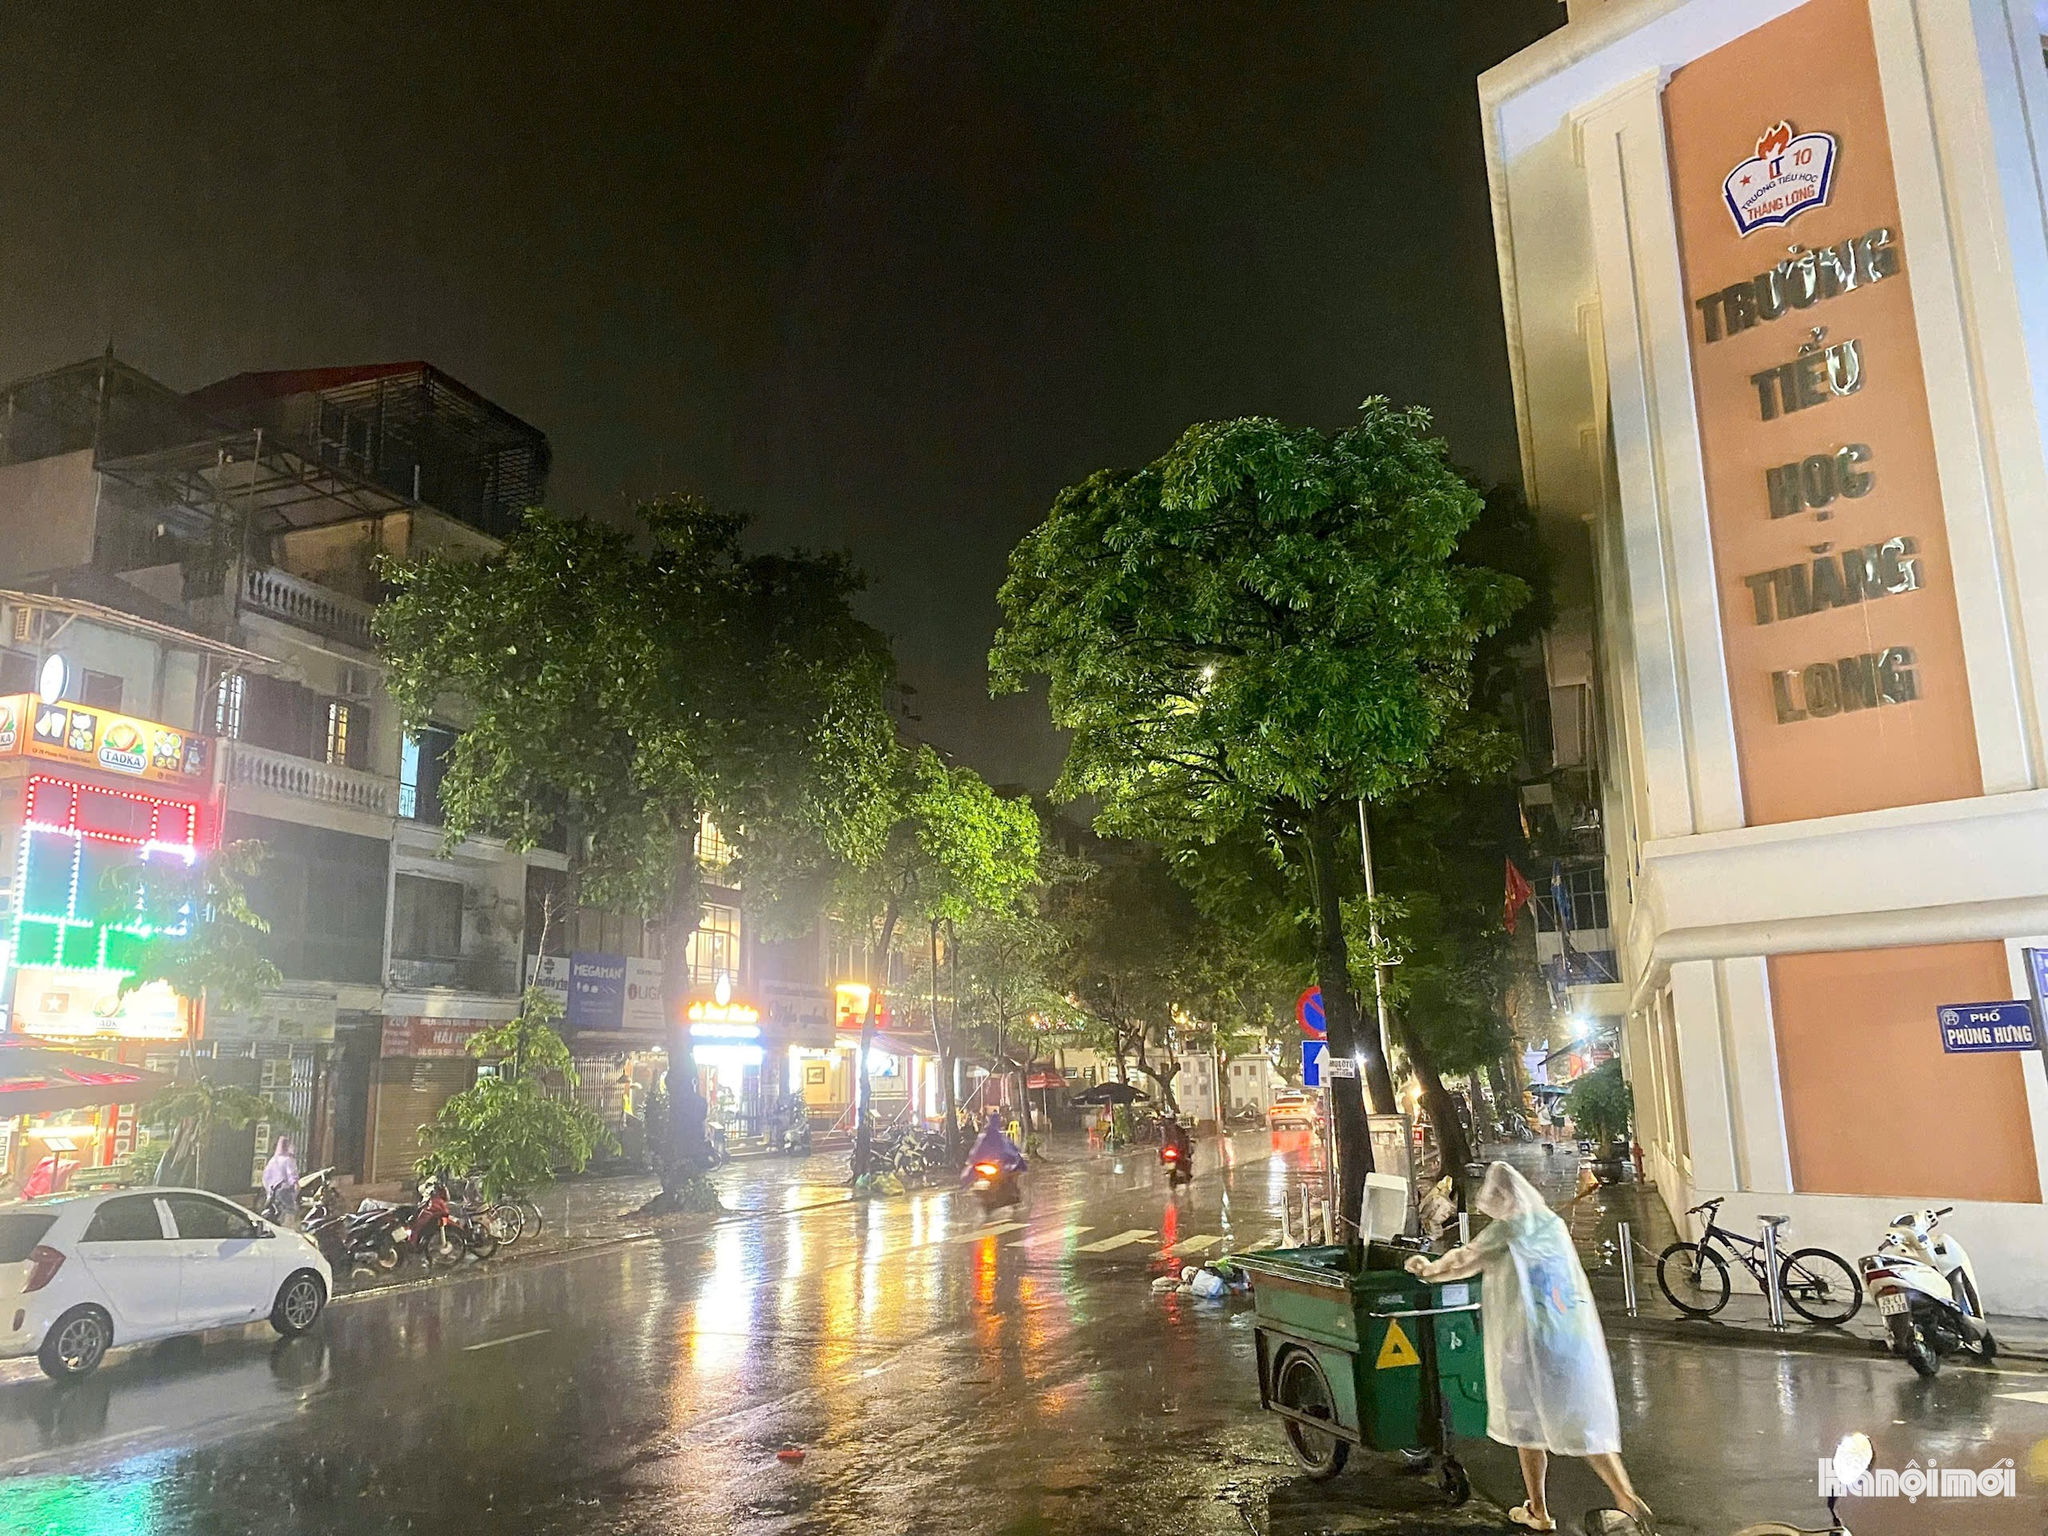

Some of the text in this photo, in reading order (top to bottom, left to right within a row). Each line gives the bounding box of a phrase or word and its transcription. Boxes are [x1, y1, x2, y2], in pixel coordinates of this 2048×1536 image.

[1793, 148, 1812, 166] 10
[1785, 184, 1815, 205] LONG
[1751, 326, 1867, 422] TIỂU
[1766, 443, 1875, 521] HỌC
[1745, 537, 1924, 626] THĂNG
[1770, 646, 1921, 725] LONG
[105, 751, 142, 768] TADKA
[1969, 1008, 2001, 1023] PHỐ
[1947, 1024, 2033, 1045] PHÙNG HƯNG
